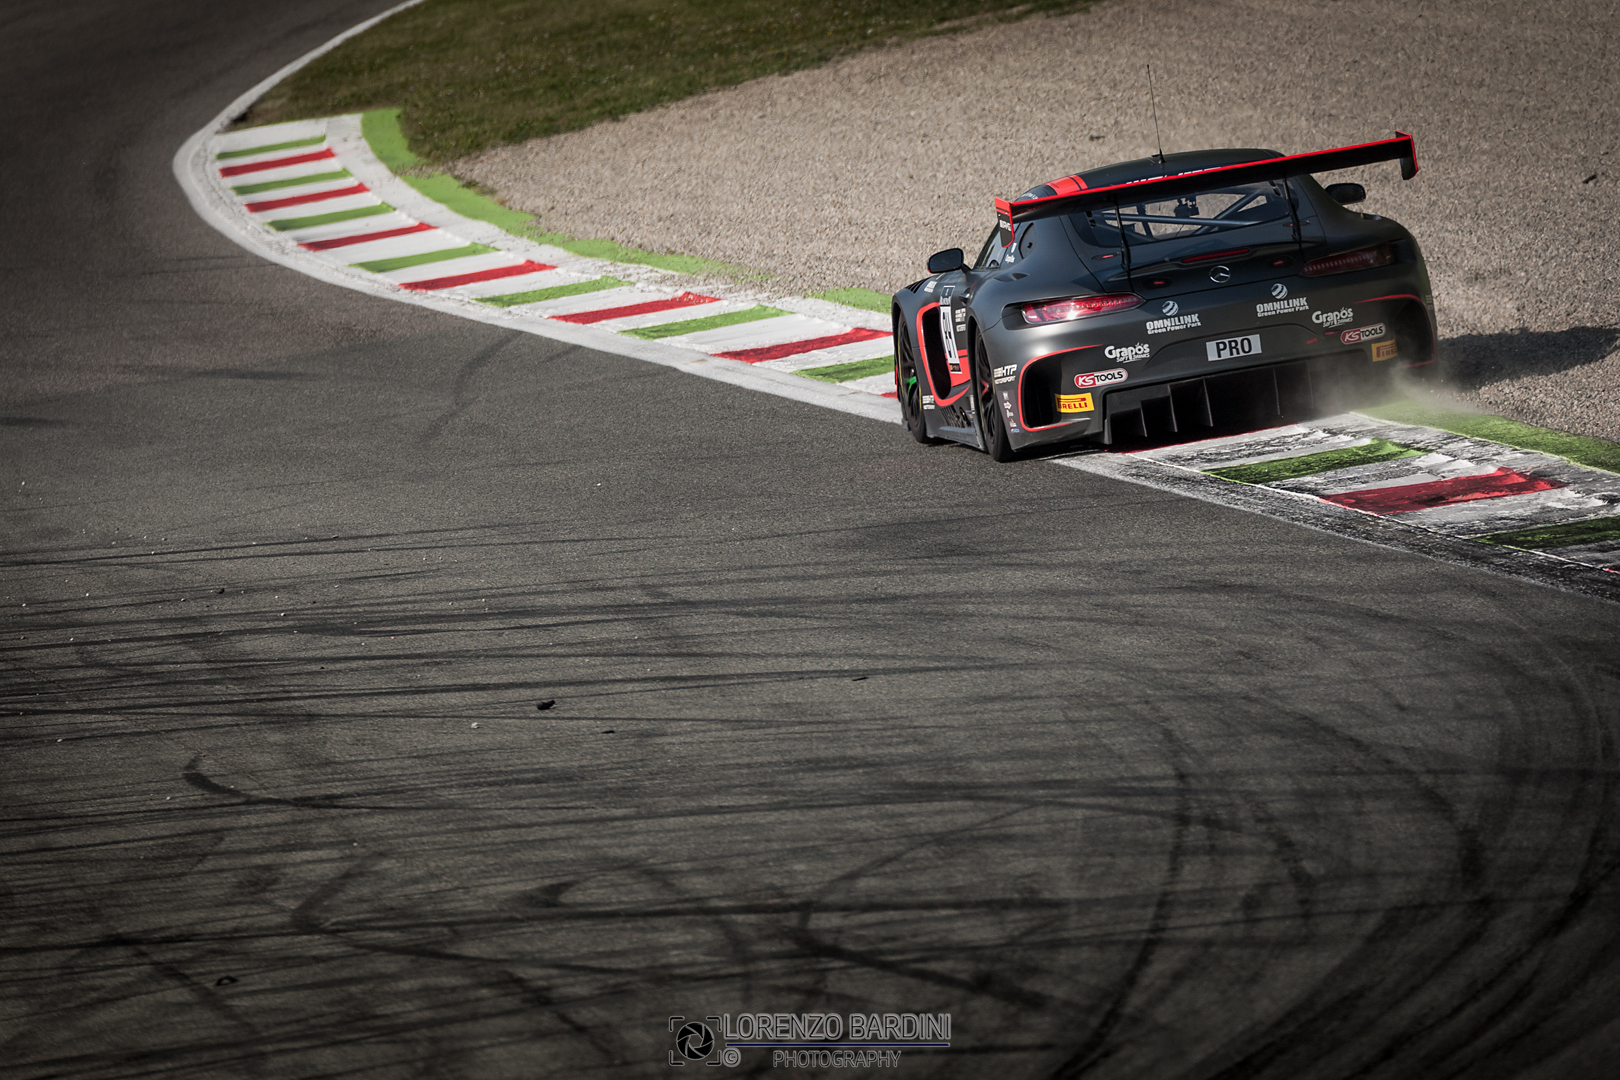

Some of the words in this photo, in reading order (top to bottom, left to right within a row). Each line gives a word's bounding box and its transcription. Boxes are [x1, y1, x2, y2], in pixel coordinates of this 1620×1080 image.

[1256, 297, 1308, 312] OMNILINK
[1146, 313, 1200, 330] OMNILINK
[1344, 331, 1360, 342] KS
[1360, 326, 1384, 338] TOOLS
[1215, 337, 1252, 358] PRO
[1078, 375, 1094, 386] KS
[1094, 371, 1124, 383] TOOLS
